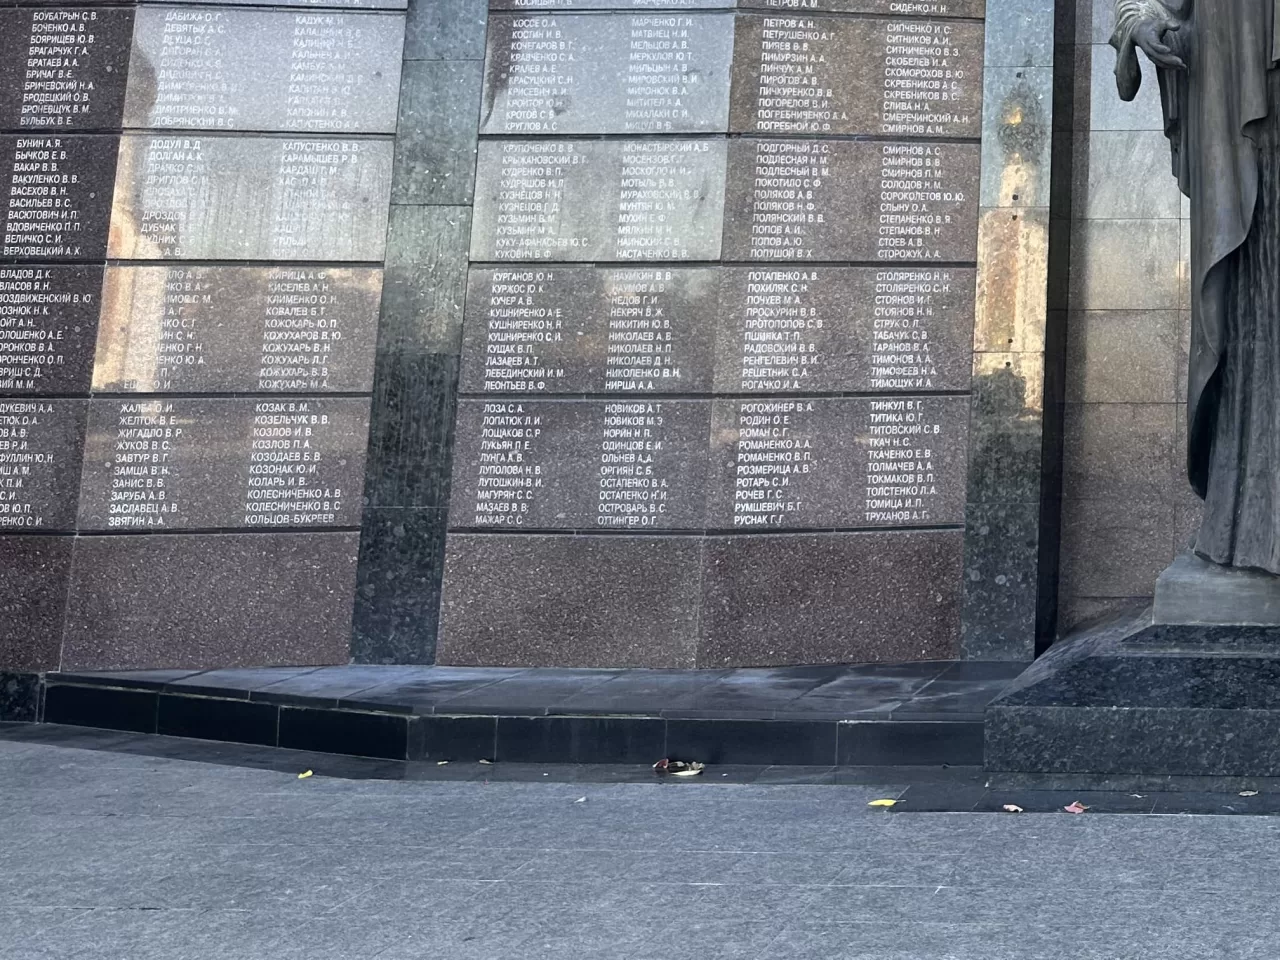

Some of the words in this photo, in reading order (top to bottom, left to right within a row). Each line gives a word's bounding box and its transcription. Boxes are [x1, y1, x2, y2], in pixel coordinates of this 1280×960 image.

[33, 11, 80, 21] БОУБАТРЫН
[31, 23, 68, 33] БОЧЕНКО
[763, 19, 796, 29] ПЕТРОВ
[30, 35, 75, 44] БОЯРИЩЕВ
[886, 36, 931, 45] СИТНИКОВ
[885, 68, 943, 78] СКОМОРОХОВ
[16, 139, 44, 149] БУНИН
[15, 151, 49, 160] БЫЧКОВ
[13, 162, 40, 172] ВАКАР
[12, 174, 60, 184] ВАКУЛЕНКО
[881, 181, 922, 190] СОЛОДОВ
[10, 186, 49, 196] ВАСЕХОВ
[881, 192, 941, 201] СОРОКОЛЕТОВ
[9, 198, 53, 208] ВАСИЛЬЕВ
[8, 210, 59, 220] ВАСЮТОВИЧ
[6, 222, 62, 232] ВДОВИЧЕНКО
[5, 234, 43, 244] ВЕЛИЧКО
[3, 246, 64, 256] ВЕРХОВЕЦКИЙ
[609, 319, 649, 329] НИКИТИН
[488, 332, 543, 342] КУШНИРЕНКО
[608, 331, 654, 341] НИКОЛАЕВ
[485, 368, 545, 378] ЛЕБЕДИНСКИЙ
[606, 368, 660, 378] НИКОЛЕНКО
[605, 381, 636, 391] НИРША
[255, 403, 286, 413] КОЗАК
[483, 403, 505, 413] ЛОЗА
[605, 404, 645, 414] НОВИКОВ
[254, 415, 308, 425] КОЗЕЛЬЧУК
[482, 417, 522, 426] ЛОПАТЮК
[740, 415, 770, 425] РОДИН
[870, 413, 903, 423] ТИТИКА
[481, 428, 524, 438] ЛОЩАКОВ
[603, 429, 632, 439] НОРИН
[870, 425, 921, 435] ТИТОВСКИЙ
[115, 441, 148, 450] ЖУКОВ
[252, 440, 290, 449] КОЗЛОВ
[602, 441, 644, 451] ОДИНЦОВ
[739, 440, 792, 450] РОМАНЕНКО
[869, 437, 891, 447] ТКАЧ
[115, 453, 150, 463] ЗАВТУР
[250, 452, 301, 462] КОЗОДАЕВ
[869, 449, 913, 459] ТКАЧЕНКО
[114, 466, 148, 476] ЗАМША
[249, 465, 293, 474] КОЗОНАК
[868, 462, 914, 471] ТОЛМАЧЕВ
[112, 478, 144, 488] ЗАНИС
[248, 477, 285, 487] КОЛАРЬ
[736, 477, 770, 487] РОТАРЬ
[867, 474, 915, 484] ТОКМАКОВ
[111, 491, 146, 501] ЗАРУБА
[247, 490, 322, 499] КОЛЕСНИЧЕНКО
[866, 487, 917, 496] ТОЛСТЕНКО
[110, 504, 159, 514] ЗАСЛАВЕЦ
[866, 499, 903, 509] ТОМИЦА
[734, 515, 768, 524] РУСНАК
[865, 511, 910, 521] ТРУХАНОВ
[108, 517, 145, 526] ЗВЯГИН
